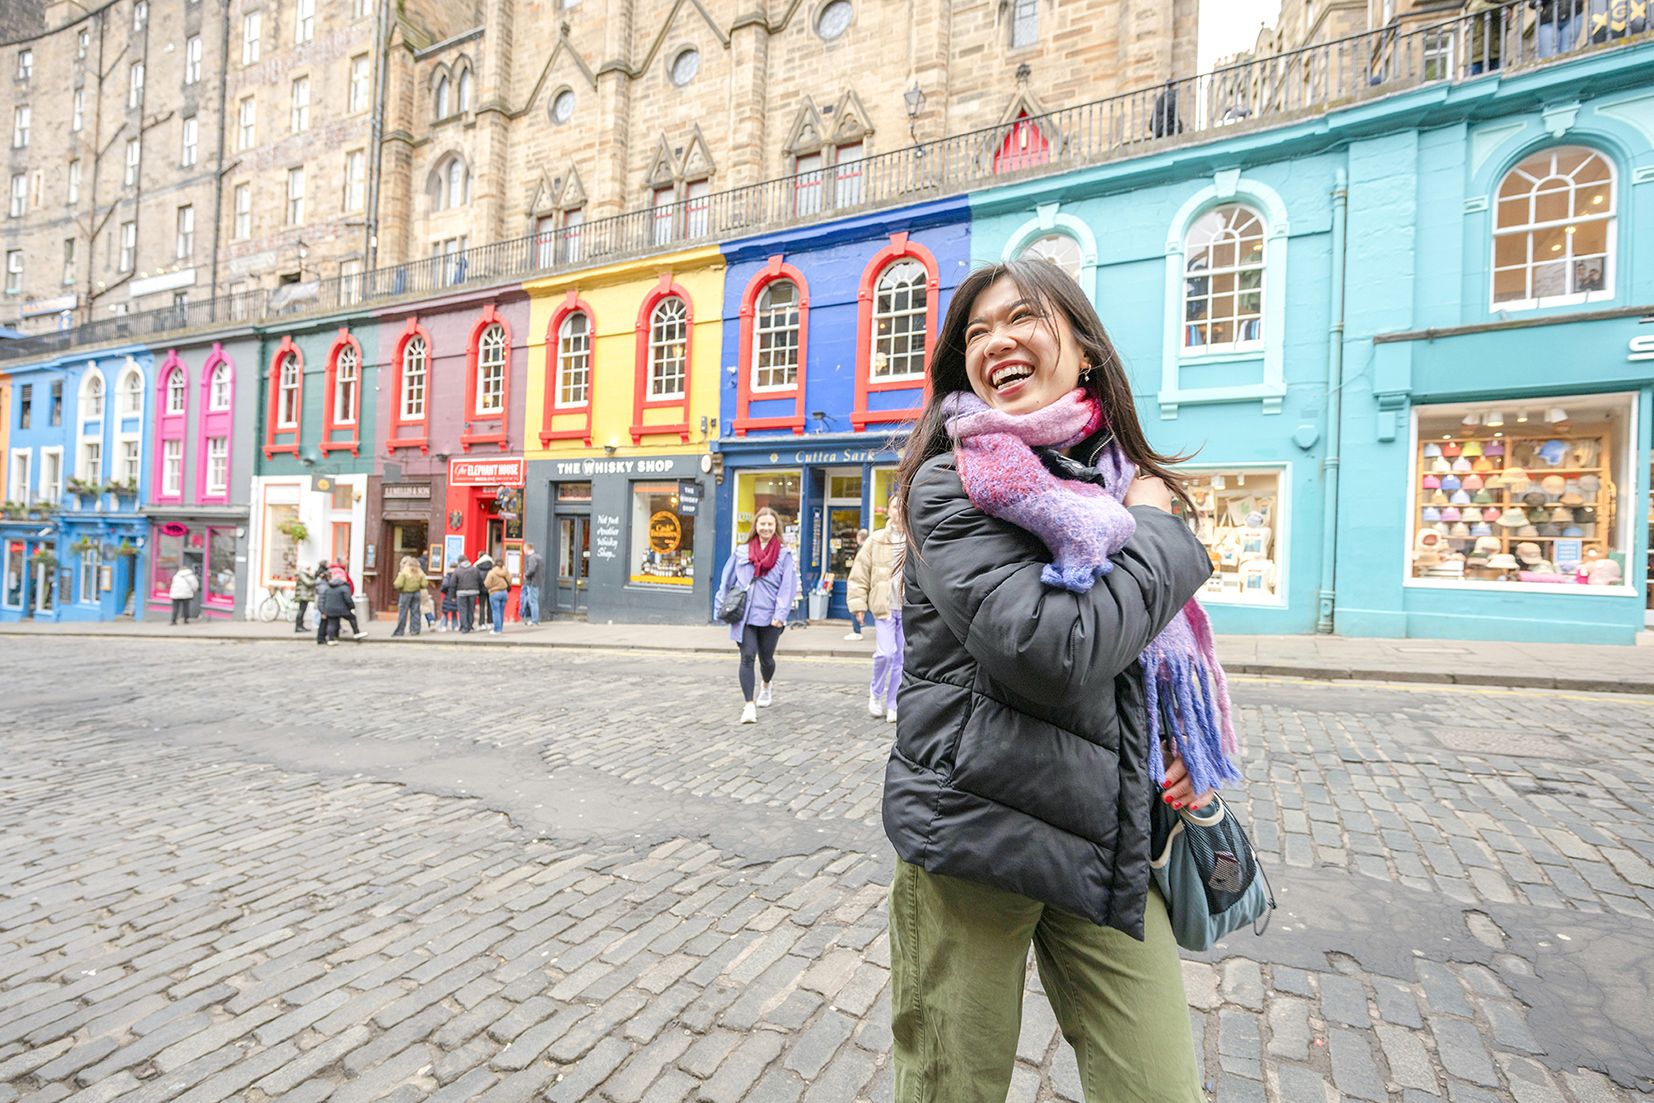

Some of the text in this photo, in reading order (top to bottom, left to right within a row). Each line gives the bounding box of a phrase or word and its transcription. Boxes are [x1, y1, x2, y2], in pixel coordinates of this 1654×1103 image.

[843, 448, 875, 462] Sark
[467, 464, 498, 476] ELEPHANT
[498, 463, 519, 476] HOUSE
[556, 460, 674, 475] THE WHISKY SHOP
[684, 486, 694, 495] THE
[682, 504, 696, 512] SHOP
